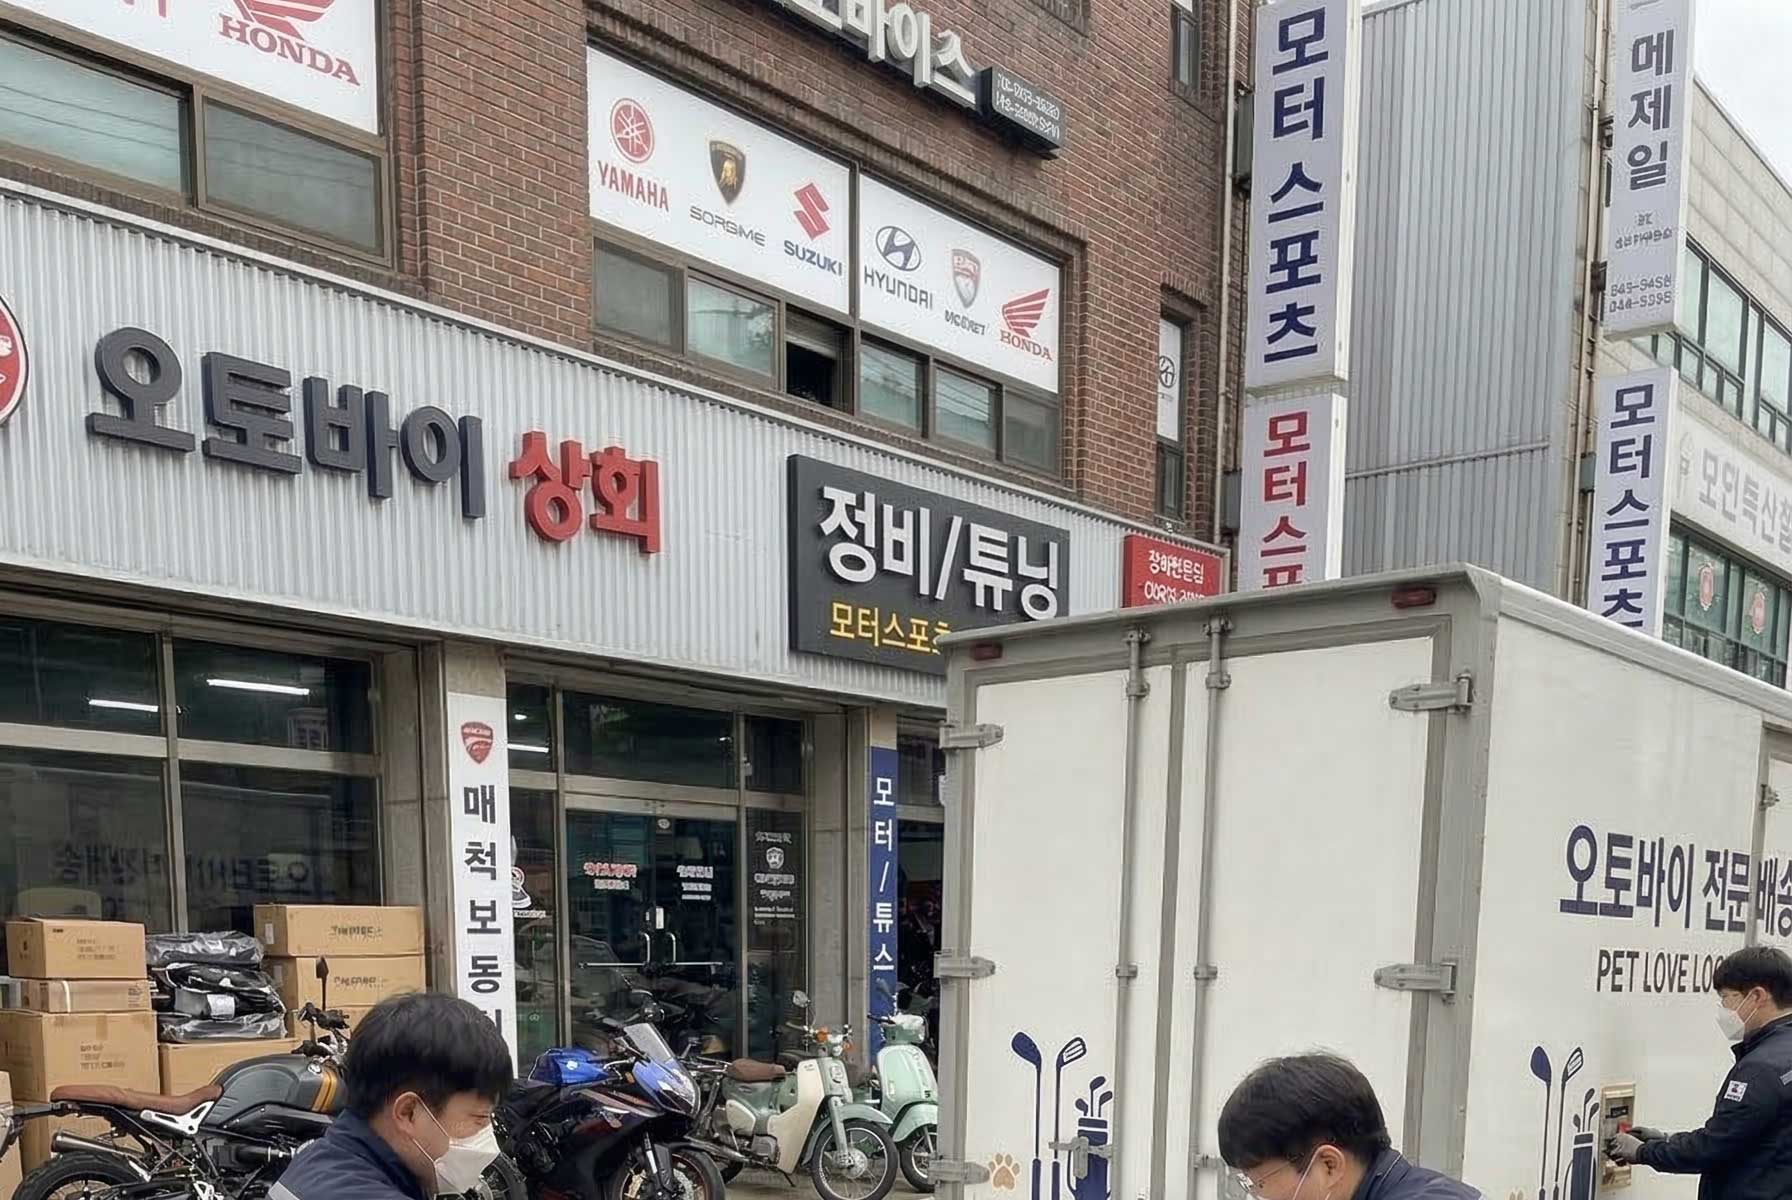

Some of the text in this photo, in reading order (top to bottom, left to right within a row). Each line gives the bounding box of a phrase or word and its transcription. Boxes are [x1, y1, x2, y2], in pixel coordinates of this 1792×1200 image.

[218, 13, 361, 86] HONDA
[1627, 0, 1674, 190] 메제일
[597, 160, 670, 212] YAMAHA
[1264, 7, 1328, 363] 모터스포츠
[784, 240, 842, 276] SUZUKI
[86, 326, 661, 554] 오토바이 상회
[1600, 383, 1655, 630] 모터스포츠
[819, 485, 1058, 621] 정비/튜닝
[463, 784, 503, 1037] 매척보동
[1559, 824, 1695, 929] 오토바이
[1702, 848, 1750, 932] 전문
[1597, 949, 1639, 992] PET
[1643, 951, 1690, 993] LOVE
